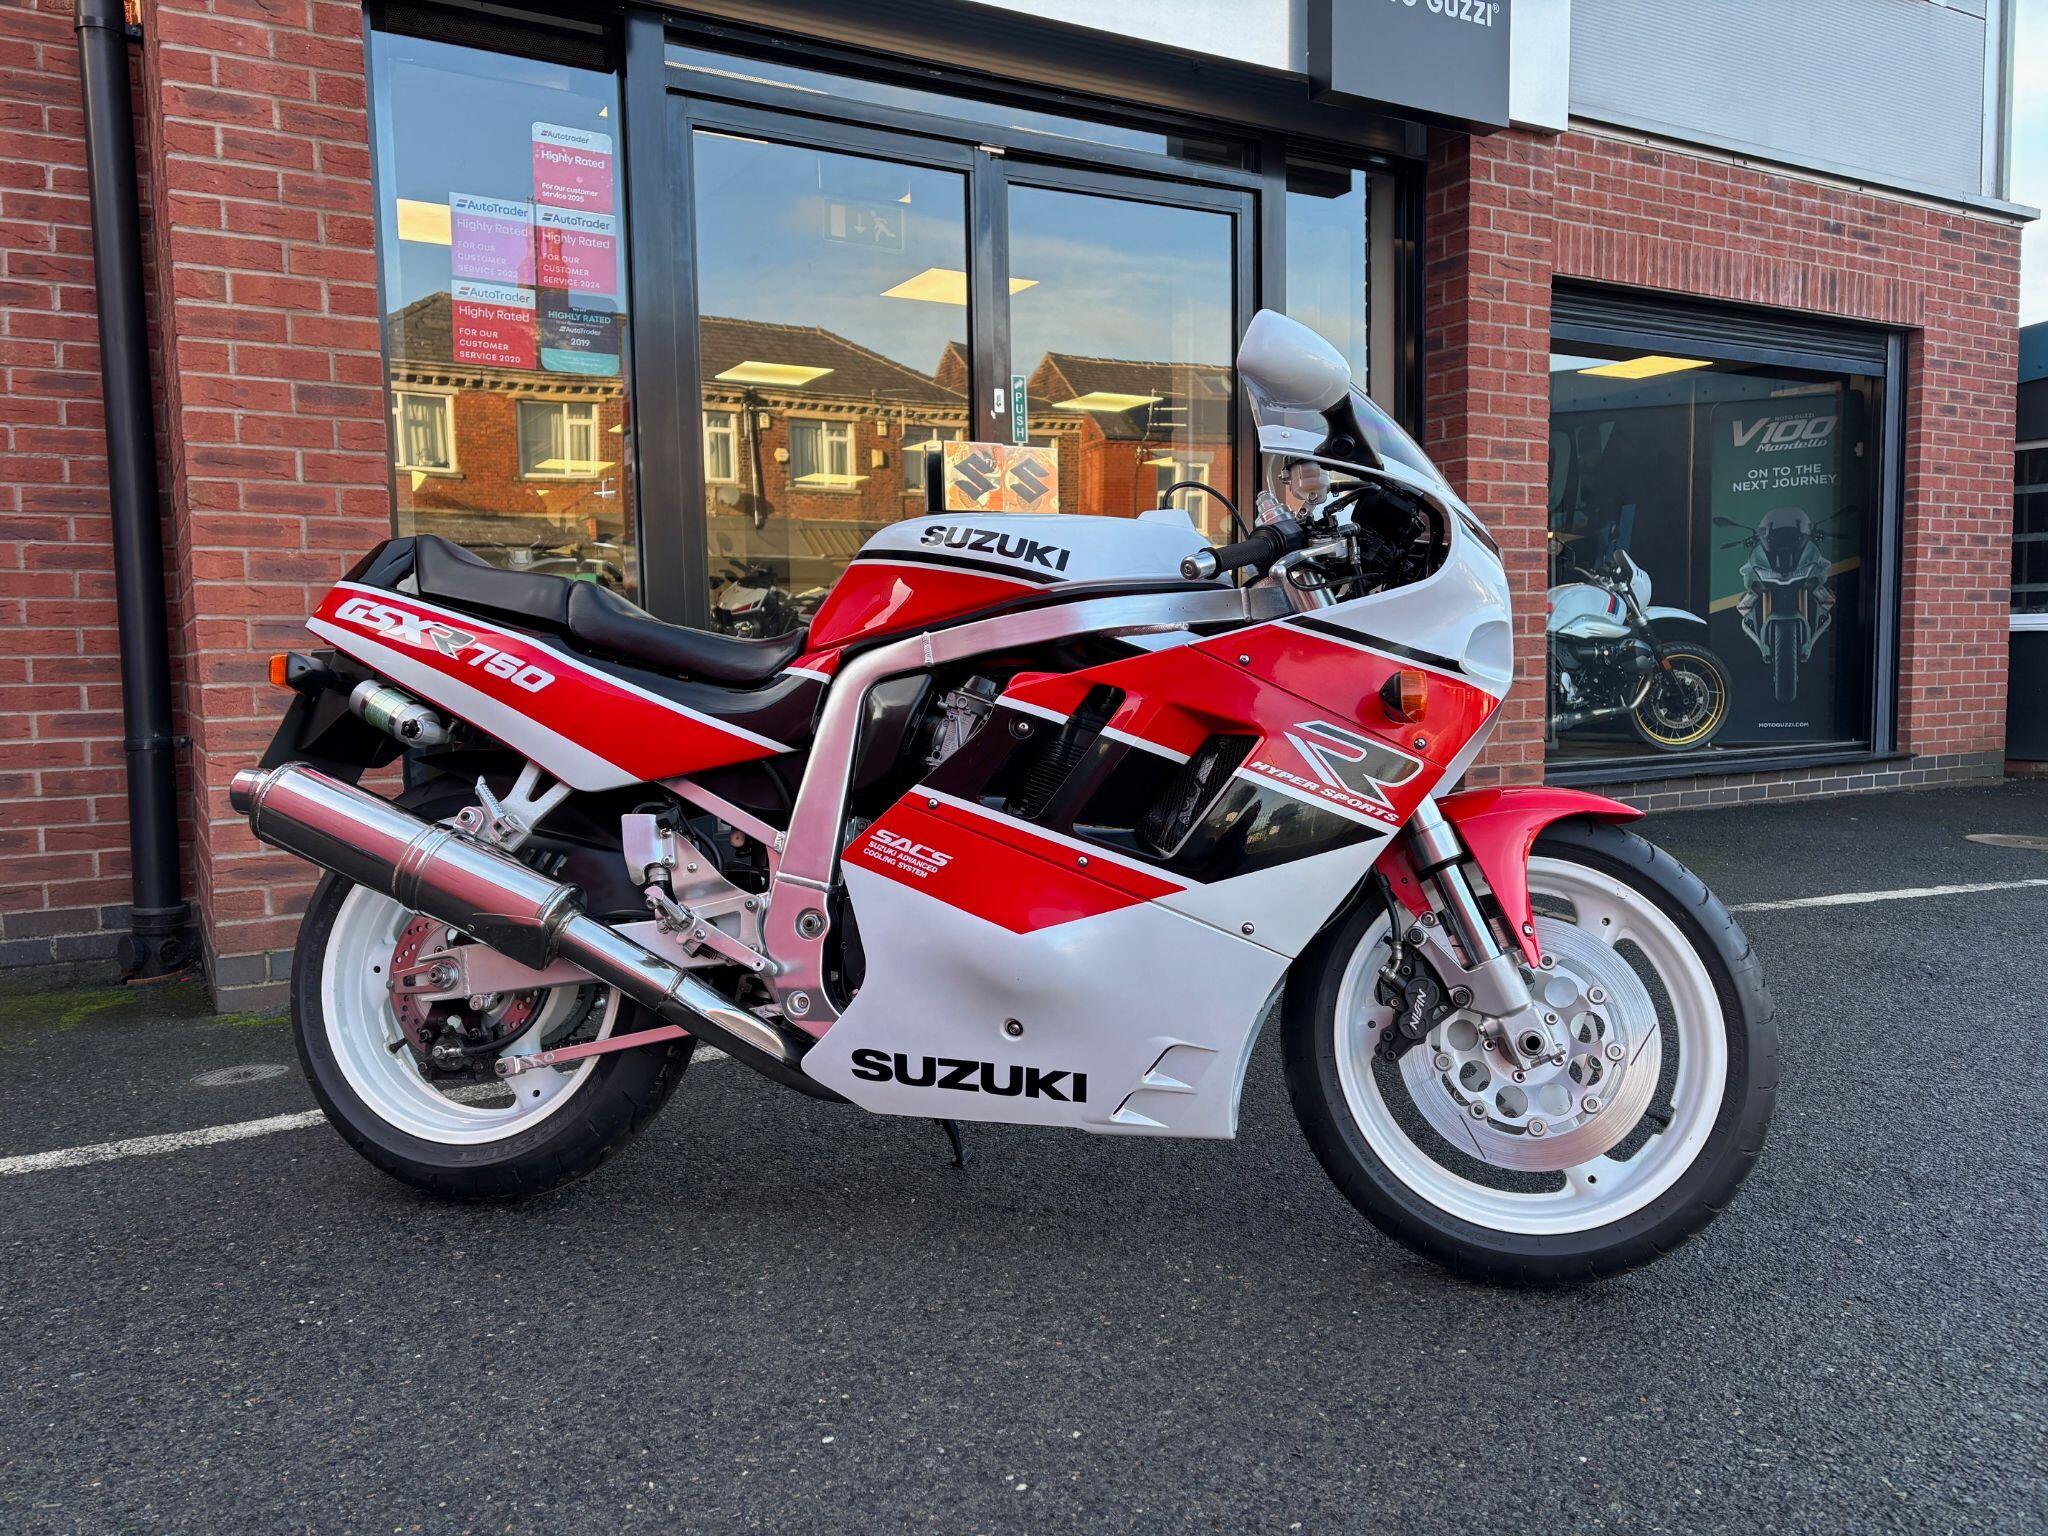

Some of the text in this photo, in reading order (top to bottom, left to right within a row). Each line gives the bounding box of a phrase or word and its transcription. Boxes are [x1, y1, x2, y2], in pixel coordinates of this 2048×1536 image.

[547, 131, 589, 143] Autotrader
[541, 150, 605, 168] Highly Rated
[542, 191, 566, 199] service
[567, 186, 598, 196] customer
[467, 201, 528, 217] AutoTrader
[457, 219, 528, 237] Highly Rated
[553, 214, 610, 230] AutoTrader
[457, 240, 496, 252] FOR OUR
[542, 231, 610, 249] Highly Rated
[457, 253, 506, 265] CUSTOMER
[543, 253, 580, 264] FOR OUR
[457, 264, 494, 276] SERVICE
[543, 264, 589, 276] CUSTOMER
[543, 276, 600, 289] SERVICE 2024
[470, 287, 530, 303] AutoTrader
[459, 305, 530, 322] Highly Rated
[548, 310, 581, 321] HIGHLY
[583, 315, 611, 324] RATED
[459, 327, 498, 338] FOR OUR
[566, 326, 601, 336] AutoTrader
[459, 339, 509, 350] CUSTOMER
[570, 337, 590, 347] 2019
[459, 350, 521, 363] SERVICE 2020
[1015, 391, 1024, 438] PUSH
[1732, 415, 1838, 447] V100
[1755, 438, 1828, 453] Mandello
[1748, 463, 1822, 479] ON TO THE
[1733, 473, 1838, 492] NEXT JOURNEY
[920, 525, 1071, 572] SUZUKI
[1249, 760, 1400, 822] HYPER SPORTS
[869, 829, 954, 867] SACS
[863, 848, 928, 879] COOLING SYSTEM
[868, 841, 938, 874] SUZUKI ADVANCED
[1409, 988, 1427, 1031] NISSIN
[850, 1048, 1087, 1104] SUZUKI
